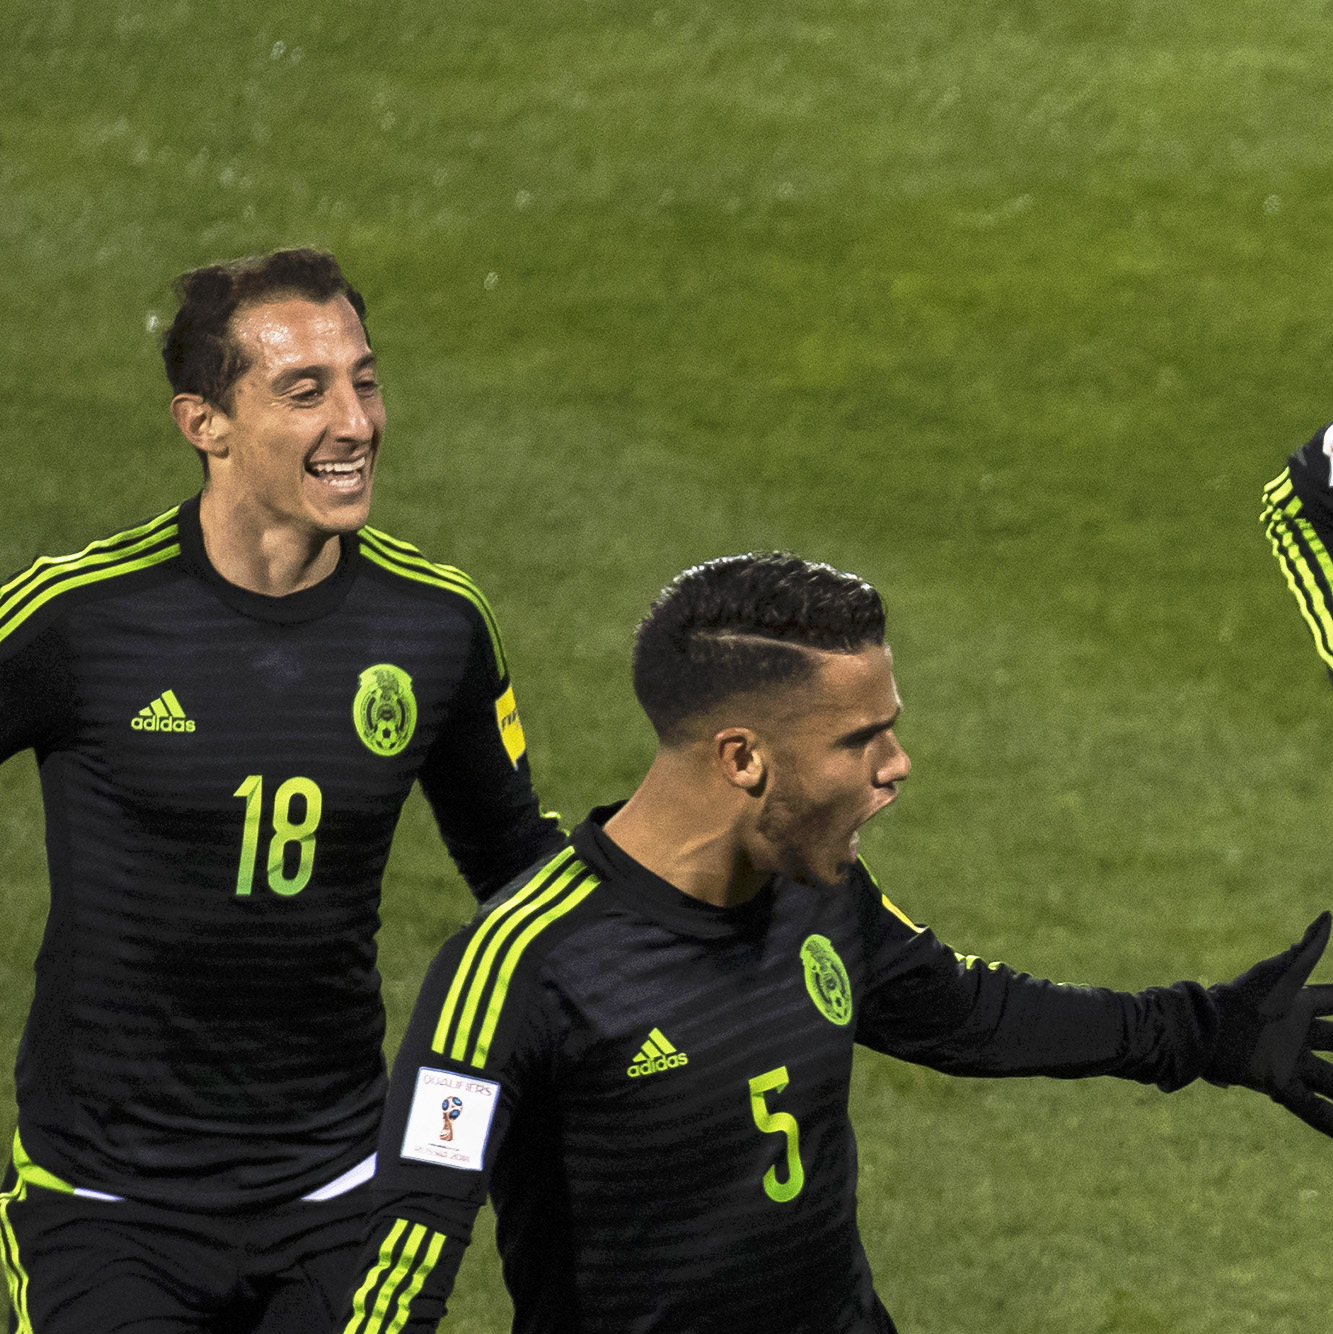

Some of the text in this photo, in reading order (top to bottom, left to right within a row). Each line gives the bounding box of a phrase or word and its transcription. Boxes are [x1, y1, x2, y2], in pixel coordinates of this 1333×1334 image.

[131, 715, 196, 733] adidas
[233, 775, 322, 896] 18
[626, 1053, 689, 1078] adidas
[749, 1066, 804, 1202] 5
